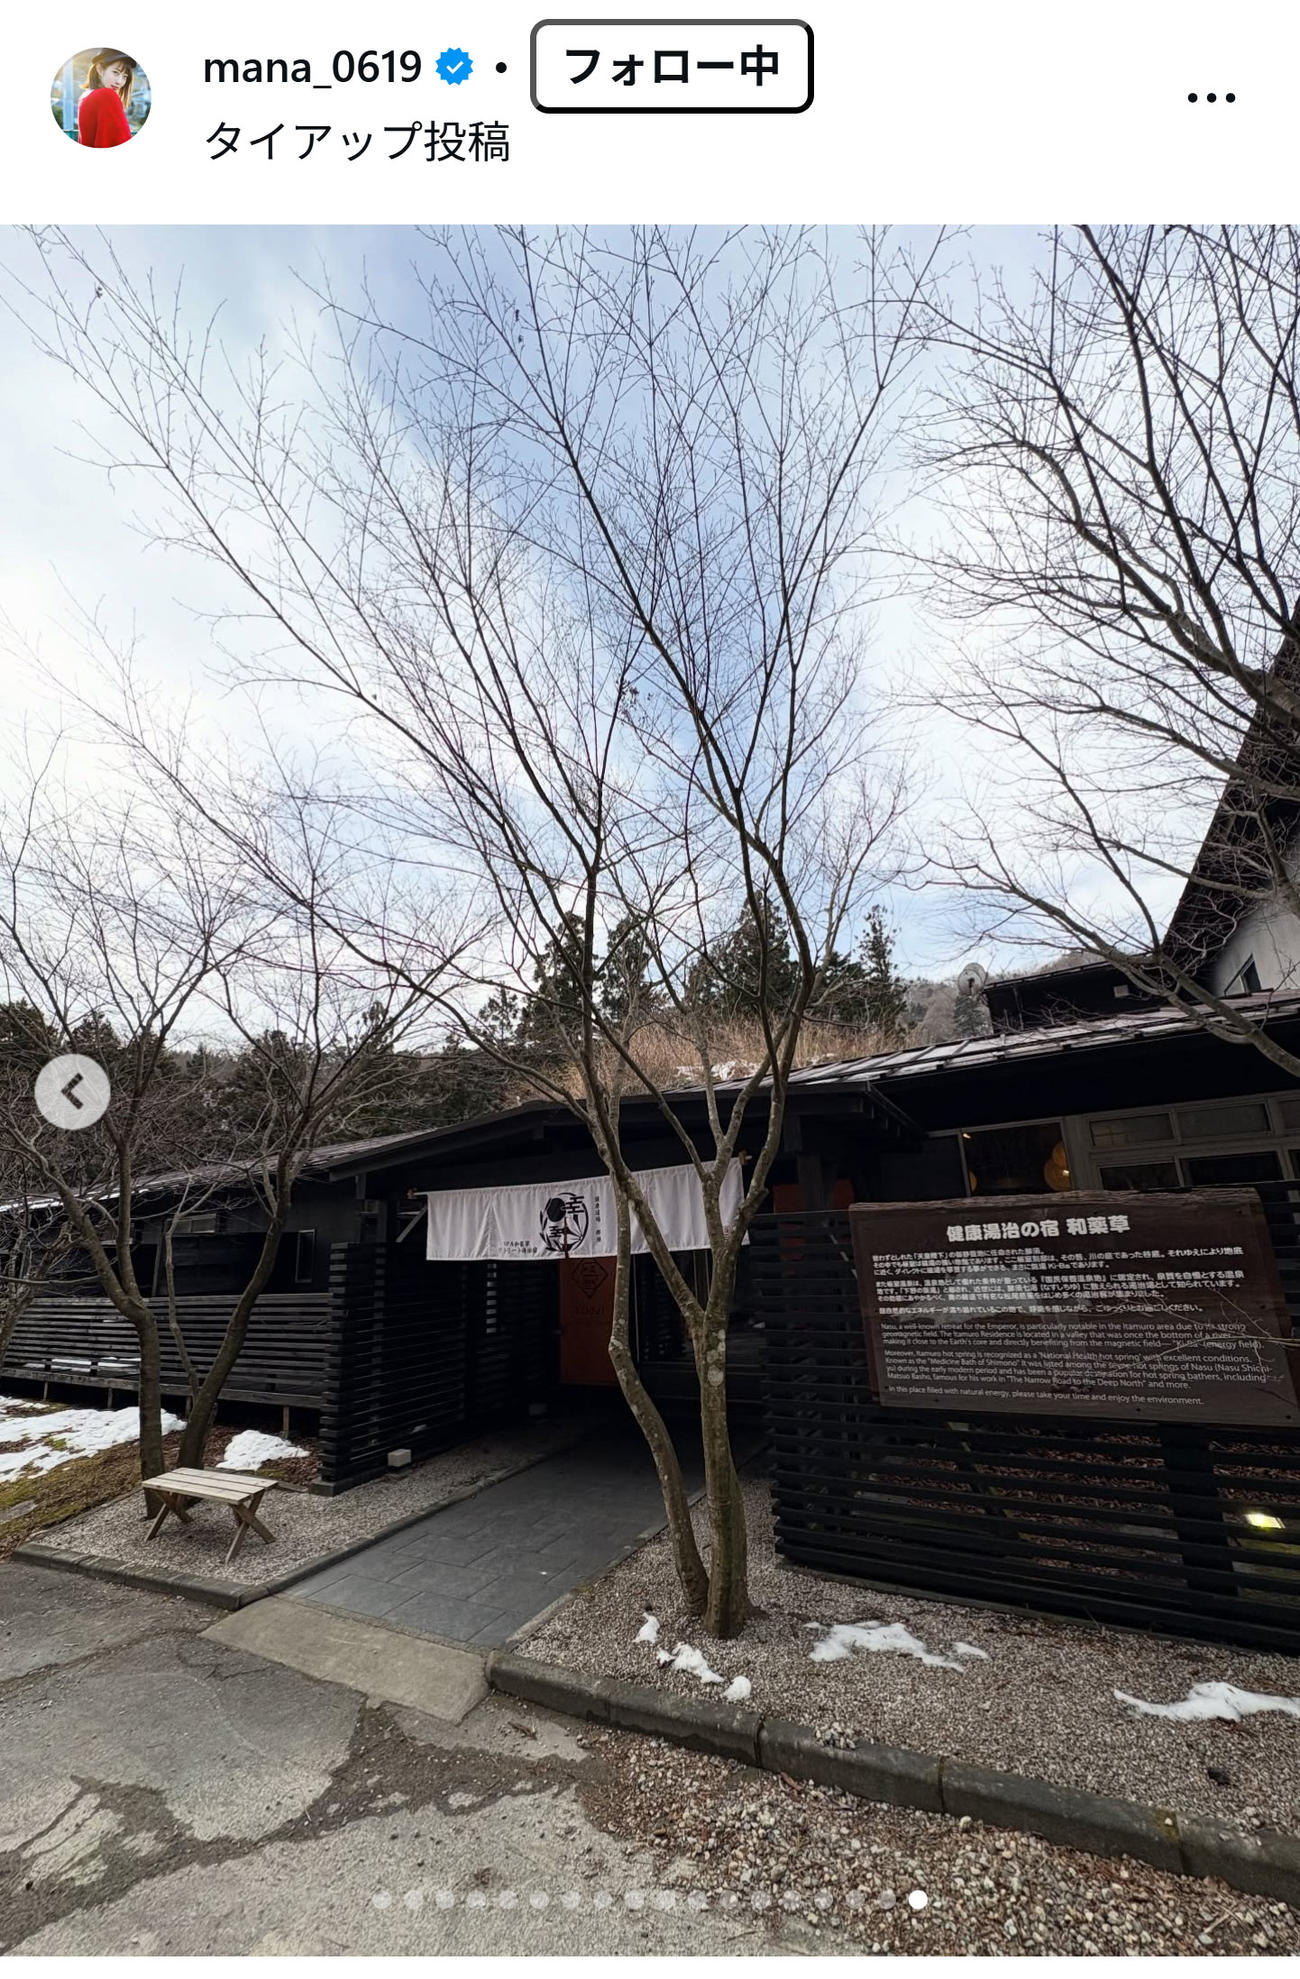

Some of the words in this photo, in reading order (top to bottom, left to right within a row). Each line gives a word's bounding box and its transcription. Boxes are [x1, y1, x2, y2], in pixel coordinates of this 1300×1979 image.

[946, 1219, 1060, 1242] 健康湯治の宿
[1066, 1215, 1130, 1236] 和薬草
[1066, 1331, 1088, 1340] valley
[883, 1338, 906, 1346] making
[1003, 1339, 1029, 1347] directly
[1104, 1339, 1142, 1348] magnetic
[884, 1350, 916, 1359] Moreover,
[955, 1351, 976, 1360] spring
[897, 1365, 918, 1374] during
[931, 1366, 946, 1374] early
[948, 1366, 974, 1374] modern
[975, 1367, 998, 1376] period
[1130, 1370, 1141, 1378] for
[1159, 1371, 1185, 1381] spring
[1187, 1372, 1222, 1382] bathers,
[1065, 1362, 1092, 1370] among
[1191, 1363, 1213, 1371] Nasu
[1215, 1363, 1240, 1373] (Nasu
[933, 1373, 957, 1381] famous
[1024, 1376, 1051, 1384] Narrow
[1097, 1378, 1119, 1388] Deep
[1148, 1380, 1164, 1388] and
[909, 1386, 926, 1395] place
[985, 1390, 1011, 1398] energy,
[1012, 1390, 1035, 1399] please
[1053, 1393, 1071, 1401] your
[1072, 1392, 1090, 1400] time
[1108, 1393, 1130, 1403] enjoy
[1132, 1394, 1146, 1402] the
